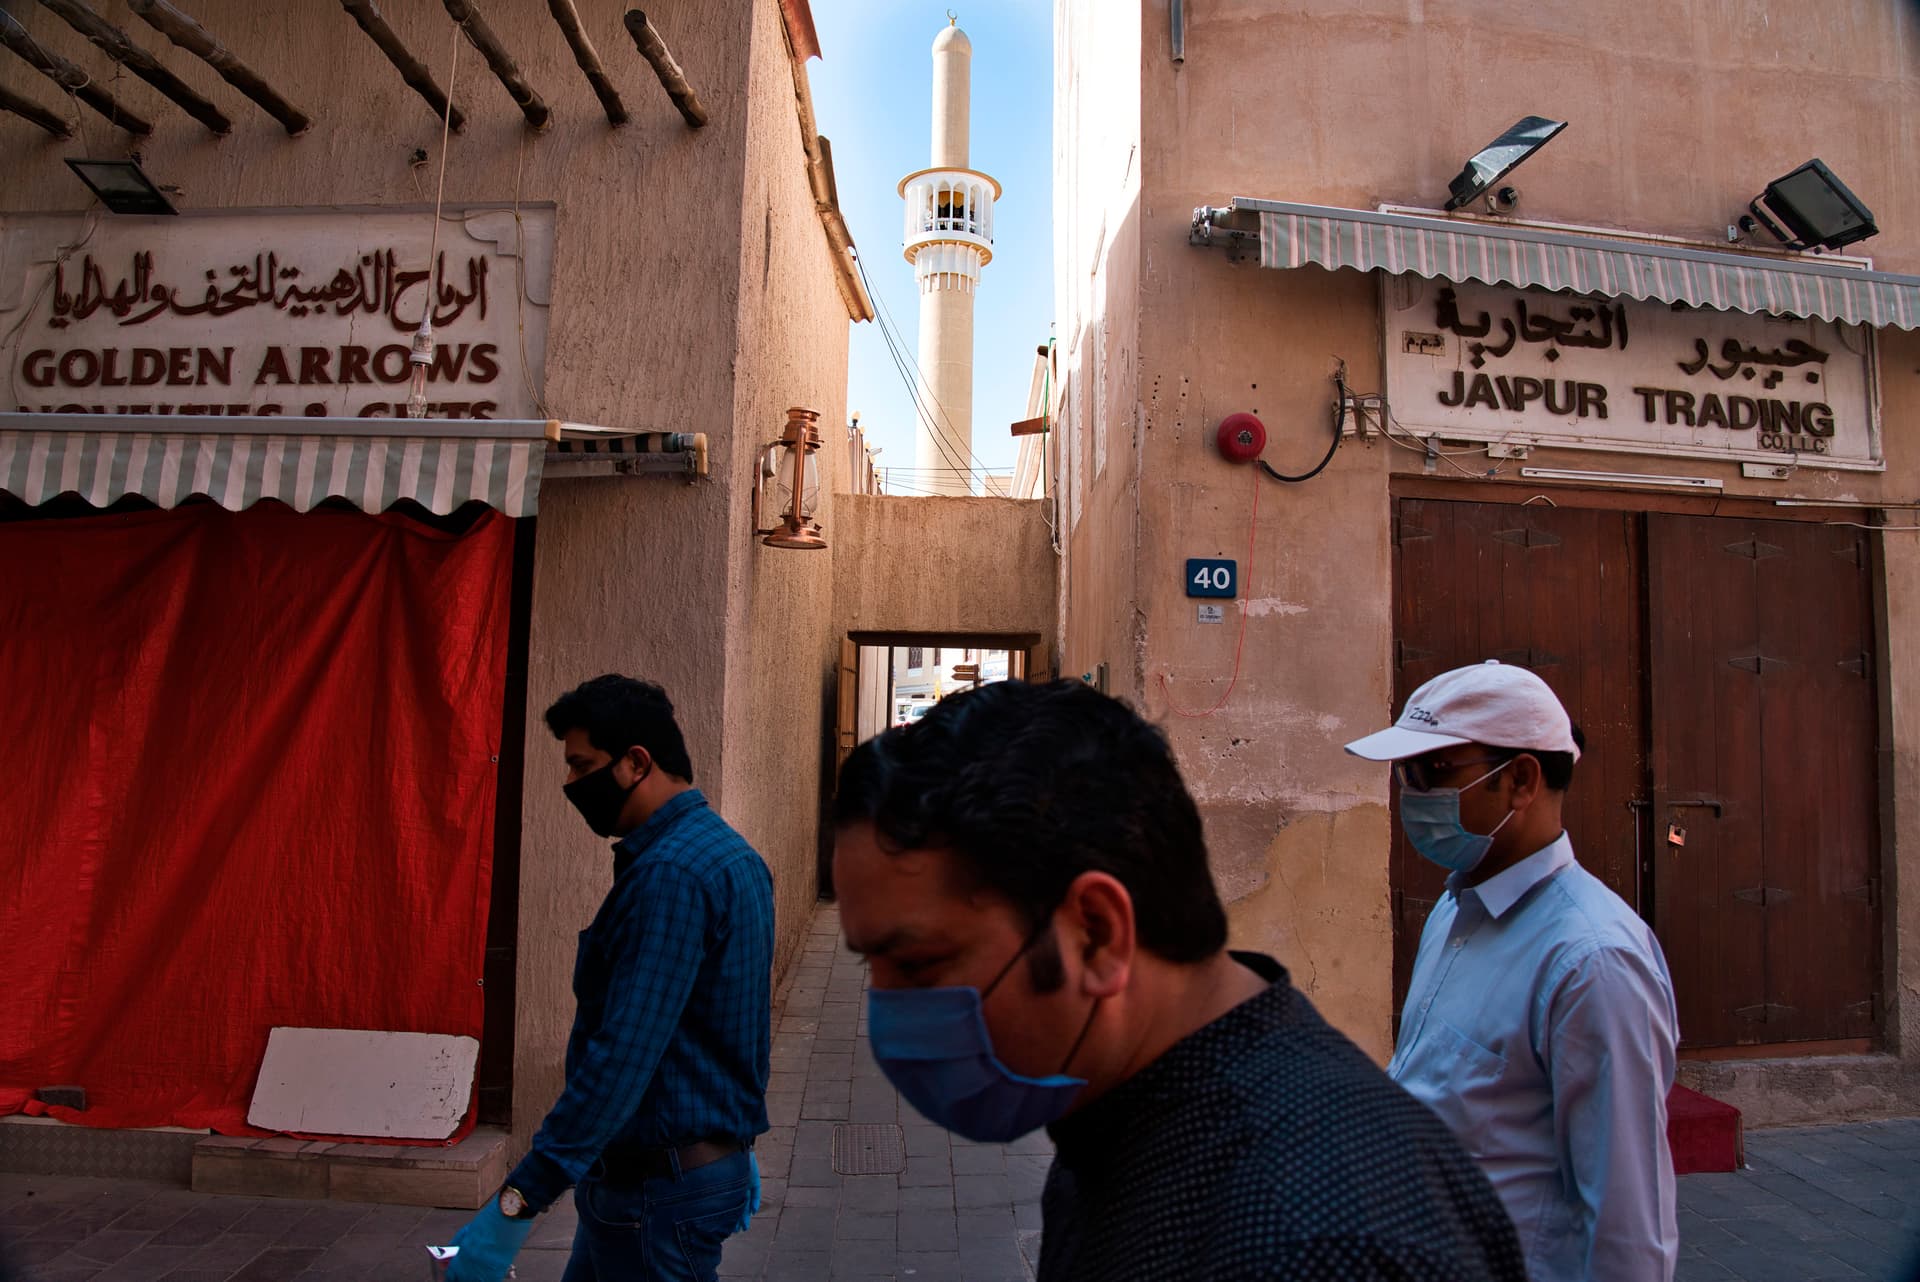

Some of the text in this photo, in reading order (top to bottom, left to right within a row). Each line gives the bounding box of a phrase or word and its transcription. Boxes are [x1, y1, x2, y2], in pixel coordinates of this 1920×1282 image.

[49, 250, 170, 329] والهدايا
[170, 250, 277, 315] للتحف
[274, 248, 394, 317] الذهبية
[1436, 287, 1629, 370] التجارية
[22, 343, 499, 388] GOLDEN ARROWS
[1439, 371, 1835, 437] JAIPUR TRADING
[1194, 567, 1231, 589] 40
